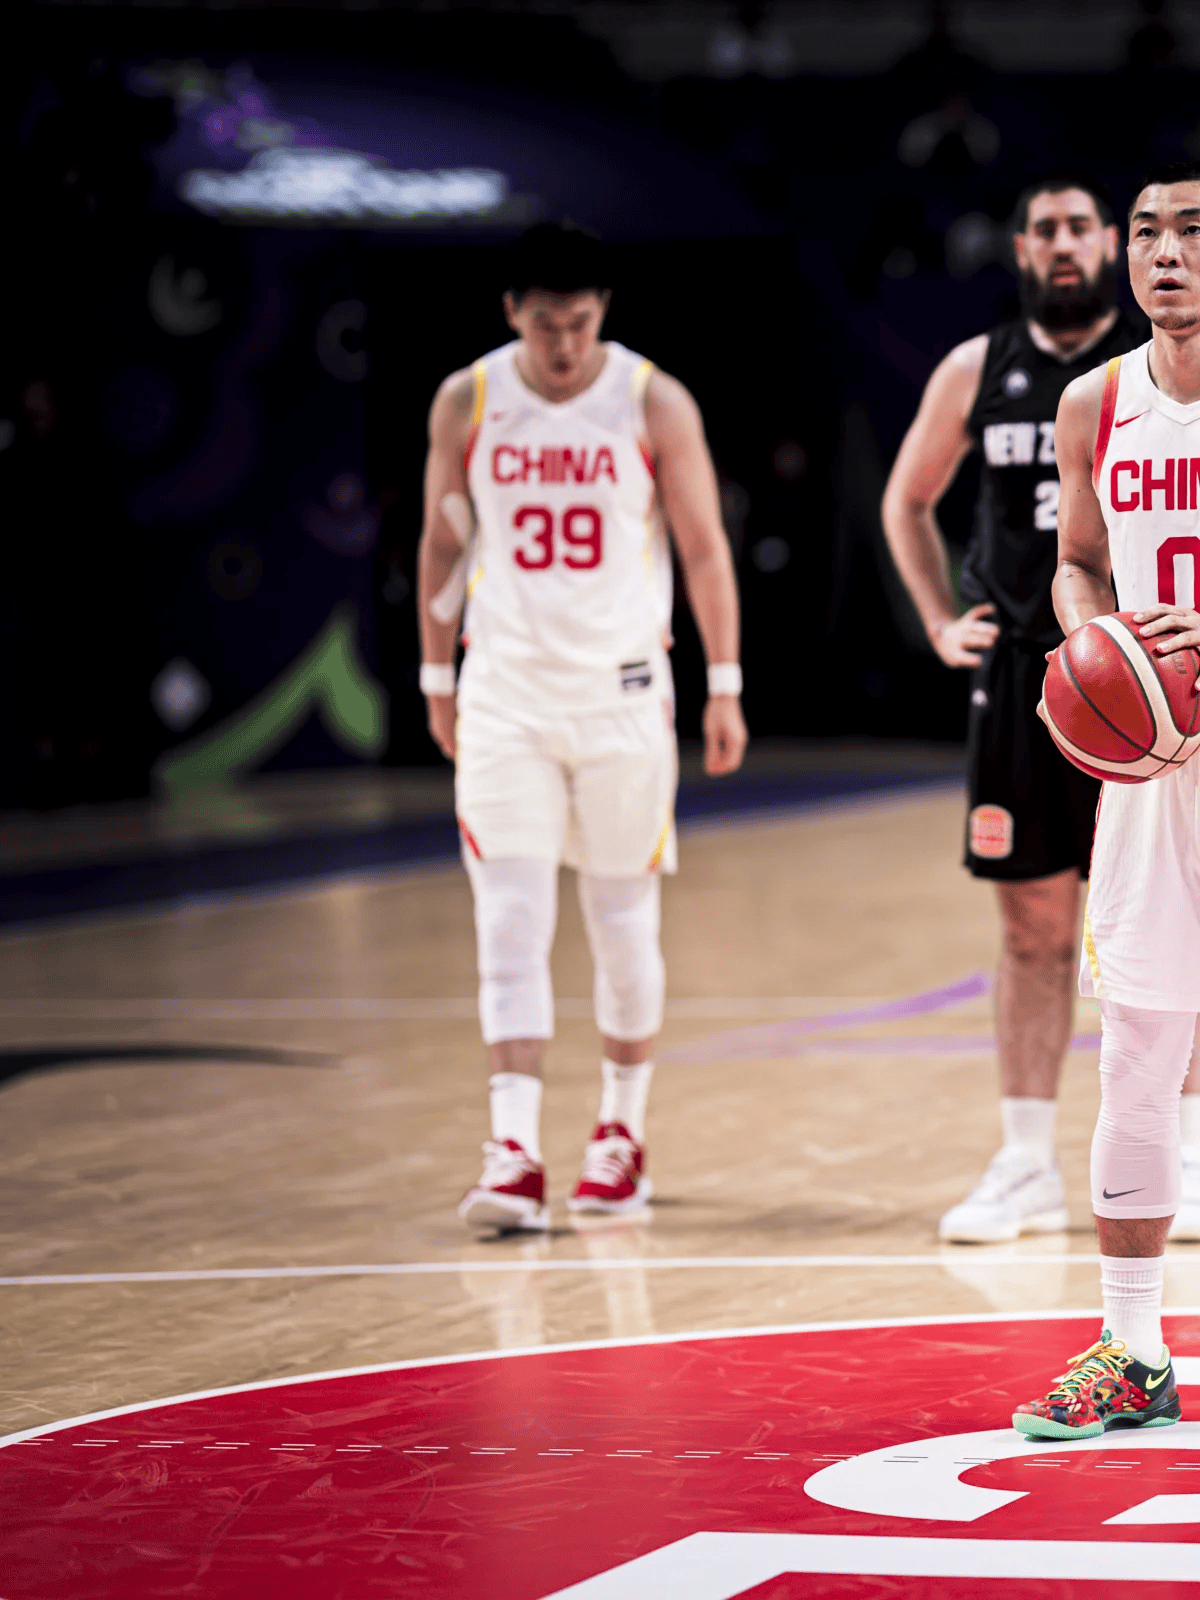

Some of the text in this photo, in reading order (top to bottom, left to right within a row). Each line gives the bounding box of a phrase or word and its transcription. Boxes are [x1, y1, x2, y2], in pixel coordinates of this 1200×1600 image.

[492, 445, 617, 485] CHINA
[1034, 481, 1060, 530] 2
[514, 505, 603, 571] 39
